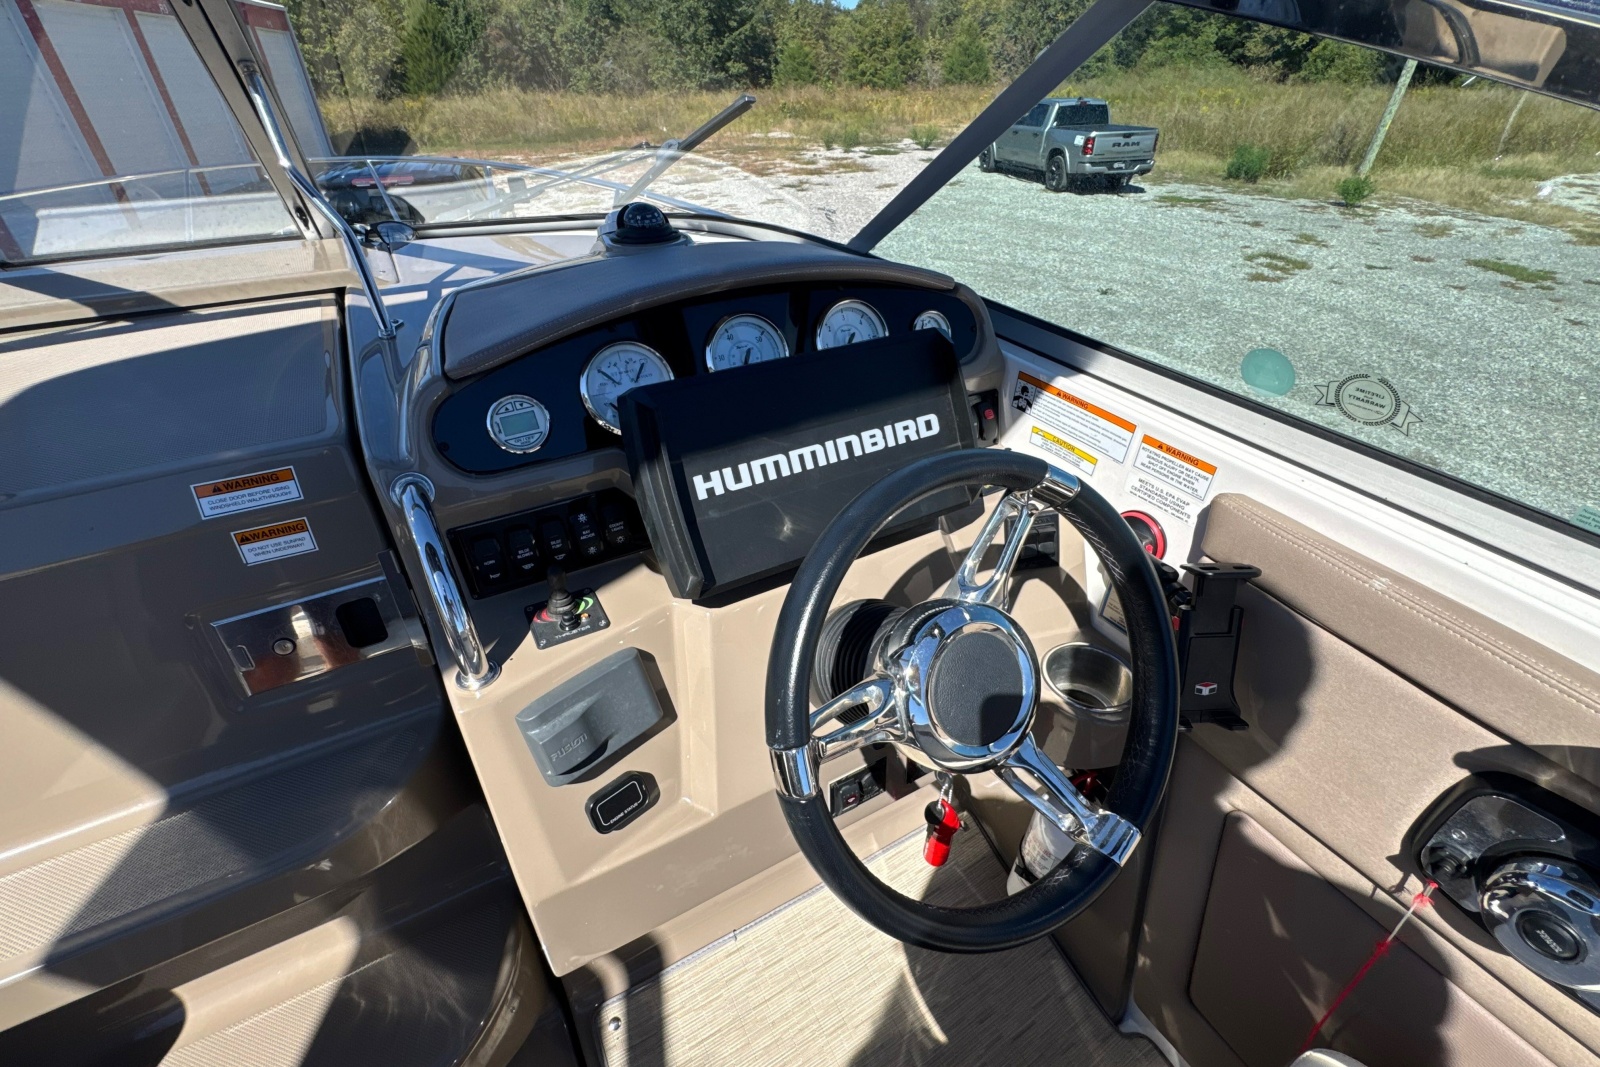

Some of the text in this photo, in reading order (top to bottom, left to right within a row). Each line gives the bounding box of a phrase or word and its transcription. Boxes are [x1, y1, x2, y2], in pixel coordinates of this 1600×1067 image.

[1062, 393, 1088, 409] WARNING
[1053, 436, 1075, 452] CAUTION
[692, 414, 940, 500] HUMMINBIRD
[1142, 447, 1160, 458] ROTATING
[1161, 456, 1184, 469] PROPELLER
[1194, 472, 1208, 480] CAUSE
[1147, 454, 1162, 464] SERIOUS
[1164, 462, 1177, 471] INJURY
[1166, 447, 1198, 465] WARNING
[222, 473, 279, 491] WARNING
[1151, 467, 1169, 478] PERSONS
[1183, 483, 1198, 492] WATER.
[1167, 470, 1181, 478] ENGINE
[207, 497, 228, 506] CLOSE
[248, 488, 271, 498] BEFORE
[272, 485, 290, 493] USING
[1138, 478, 1154, 487] MEETS
[1176, 497, 1189, 506] EVAP
[1139, 484, 1184, 509] STANDARDS USING
[208, 500, 246, 511] WINDSHIELD
[1131, 485, 1155, 499] CERTIFIED
[1156, 498, 1190, 518] COMPONENTS
[249, 523, 305, 540] WARNING
[608, 521, 624, 529] COCKPIT
[283, 537, 305, 545] SUNPAD
[580, 532, 596, 540] ANCHOR
[517, 551, 534, 559] BLOWER
[554, 625, 590, 639] THRUSTER
[550, 733, 588, 762] FUSION
[610, 802, 640, 824] ENGINE STATUS
